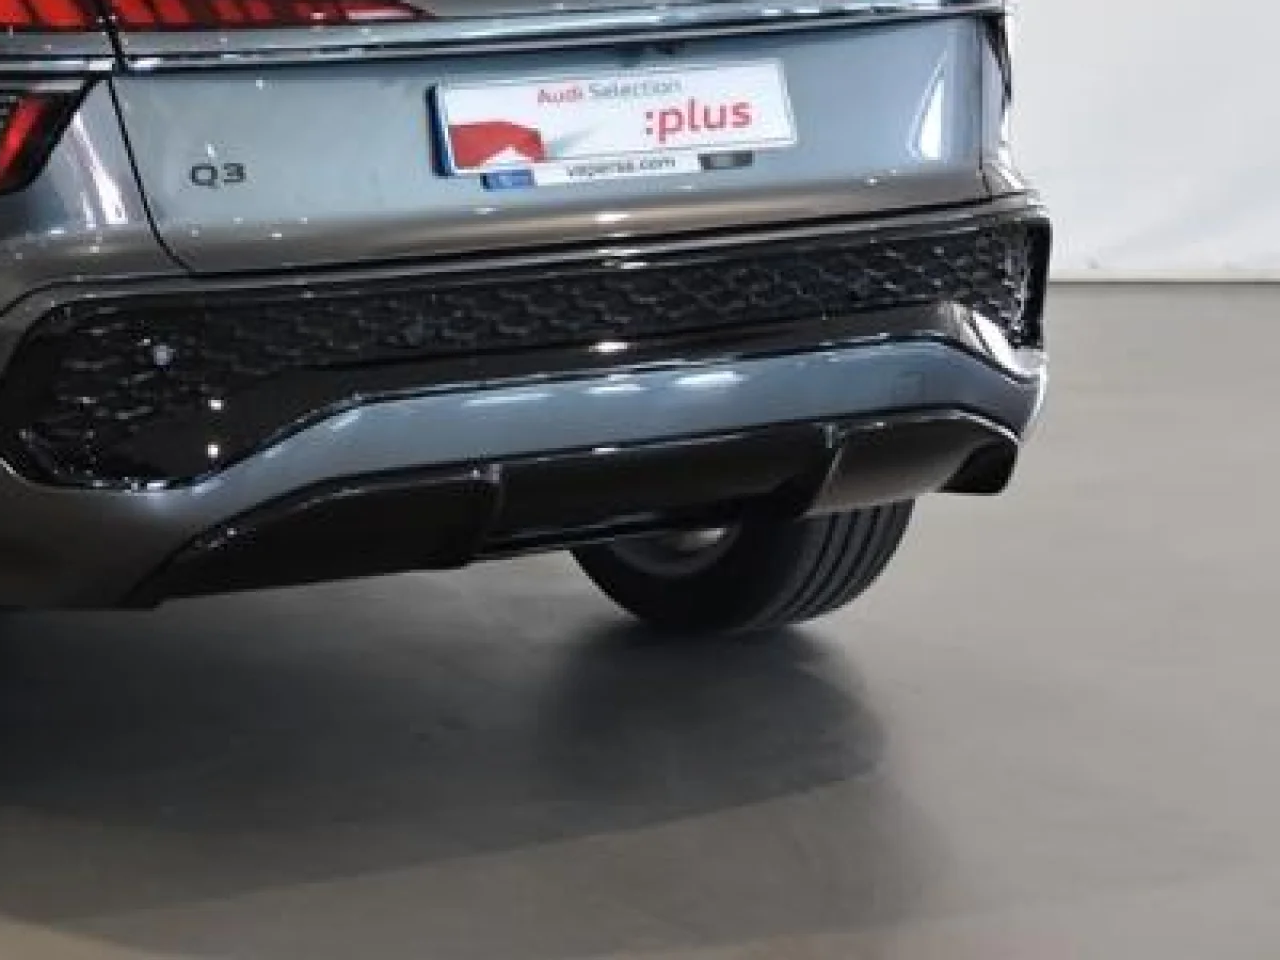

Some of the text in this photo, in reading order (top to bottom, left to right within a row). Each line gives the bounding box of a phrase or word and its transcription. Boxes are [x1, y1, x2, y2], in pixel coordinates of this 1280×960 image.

[537, 80, 683, 105] Audi Selection
[645, 97, 753, 144] :plus
[189, 162, 246, 189] Q3
